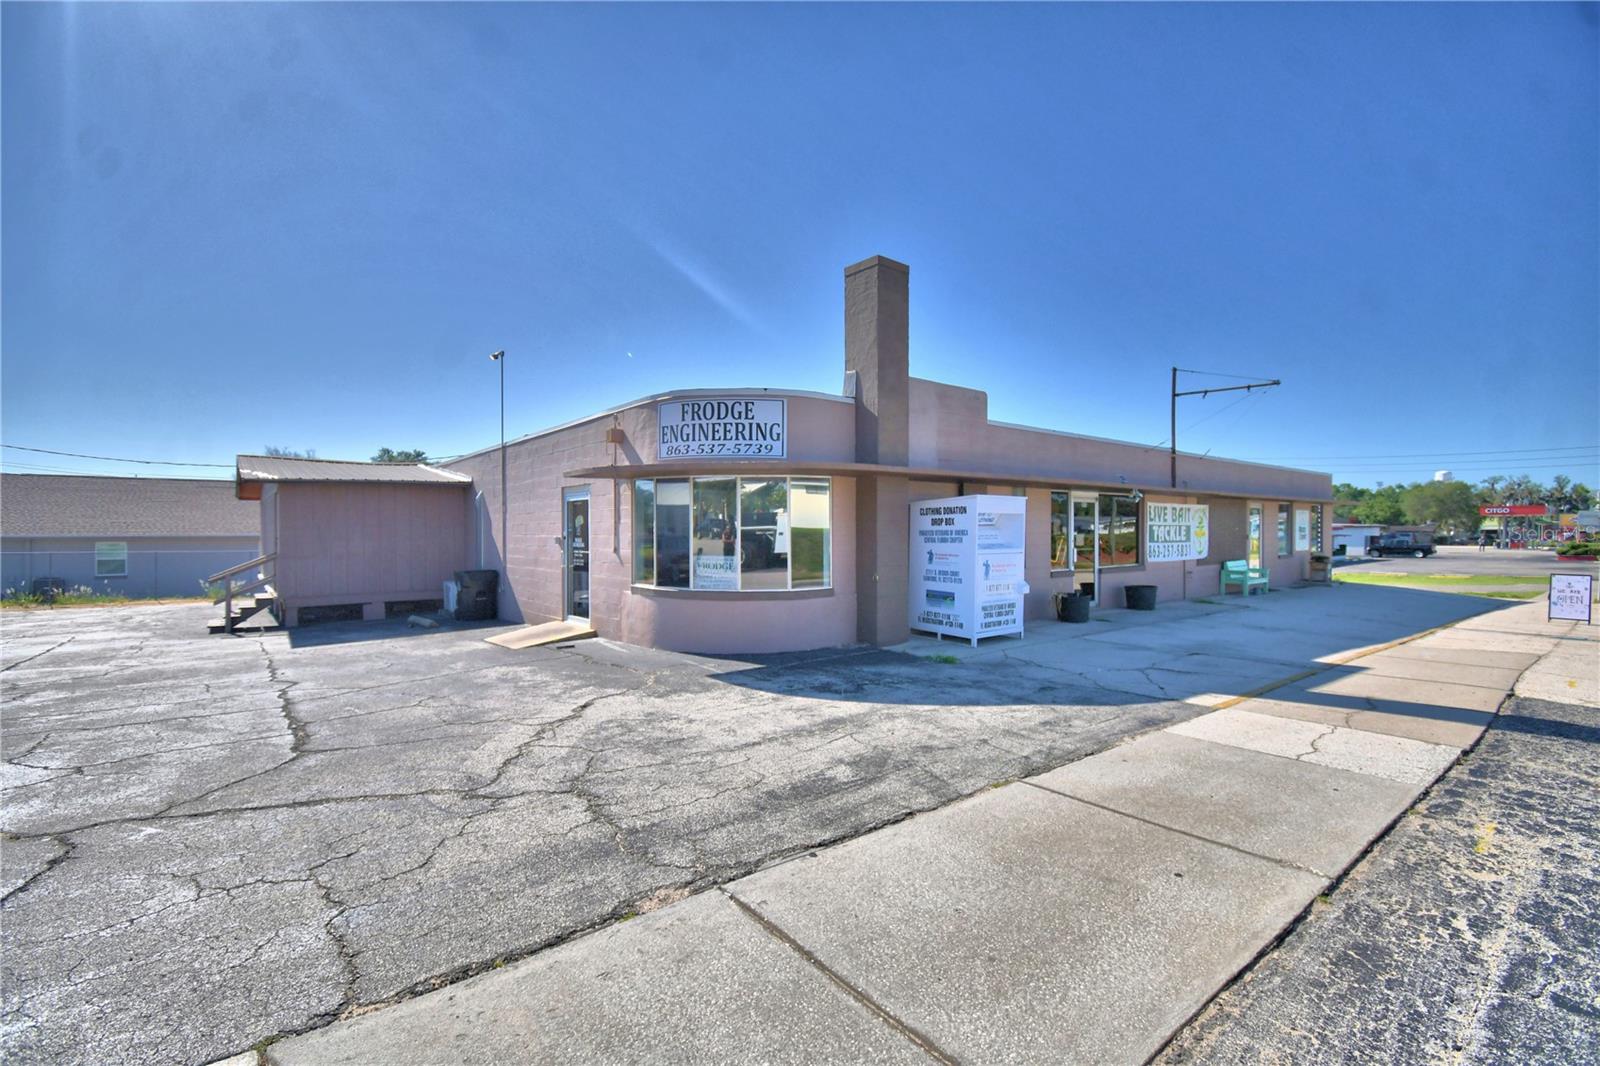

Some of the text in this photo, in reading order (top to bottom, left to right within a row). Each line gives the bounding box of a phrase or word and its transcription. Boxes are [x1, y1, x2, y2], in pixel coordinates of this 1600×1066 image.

[681, 401, 755, 421] FRODGE
[662, 422, 781, 444] ENGINEERING
[666, 443, 774, 456] 863-537-5739
[920, 506, 967, 516] CLOTHING DONATION
[1148, 505, 1191, 523] LIVE BAIT
[931, 518, 955, 526] DROP BOX
[1153, 526, 1186, 542] TACKLE
[1556, 595, 1583, 604] OPEN
